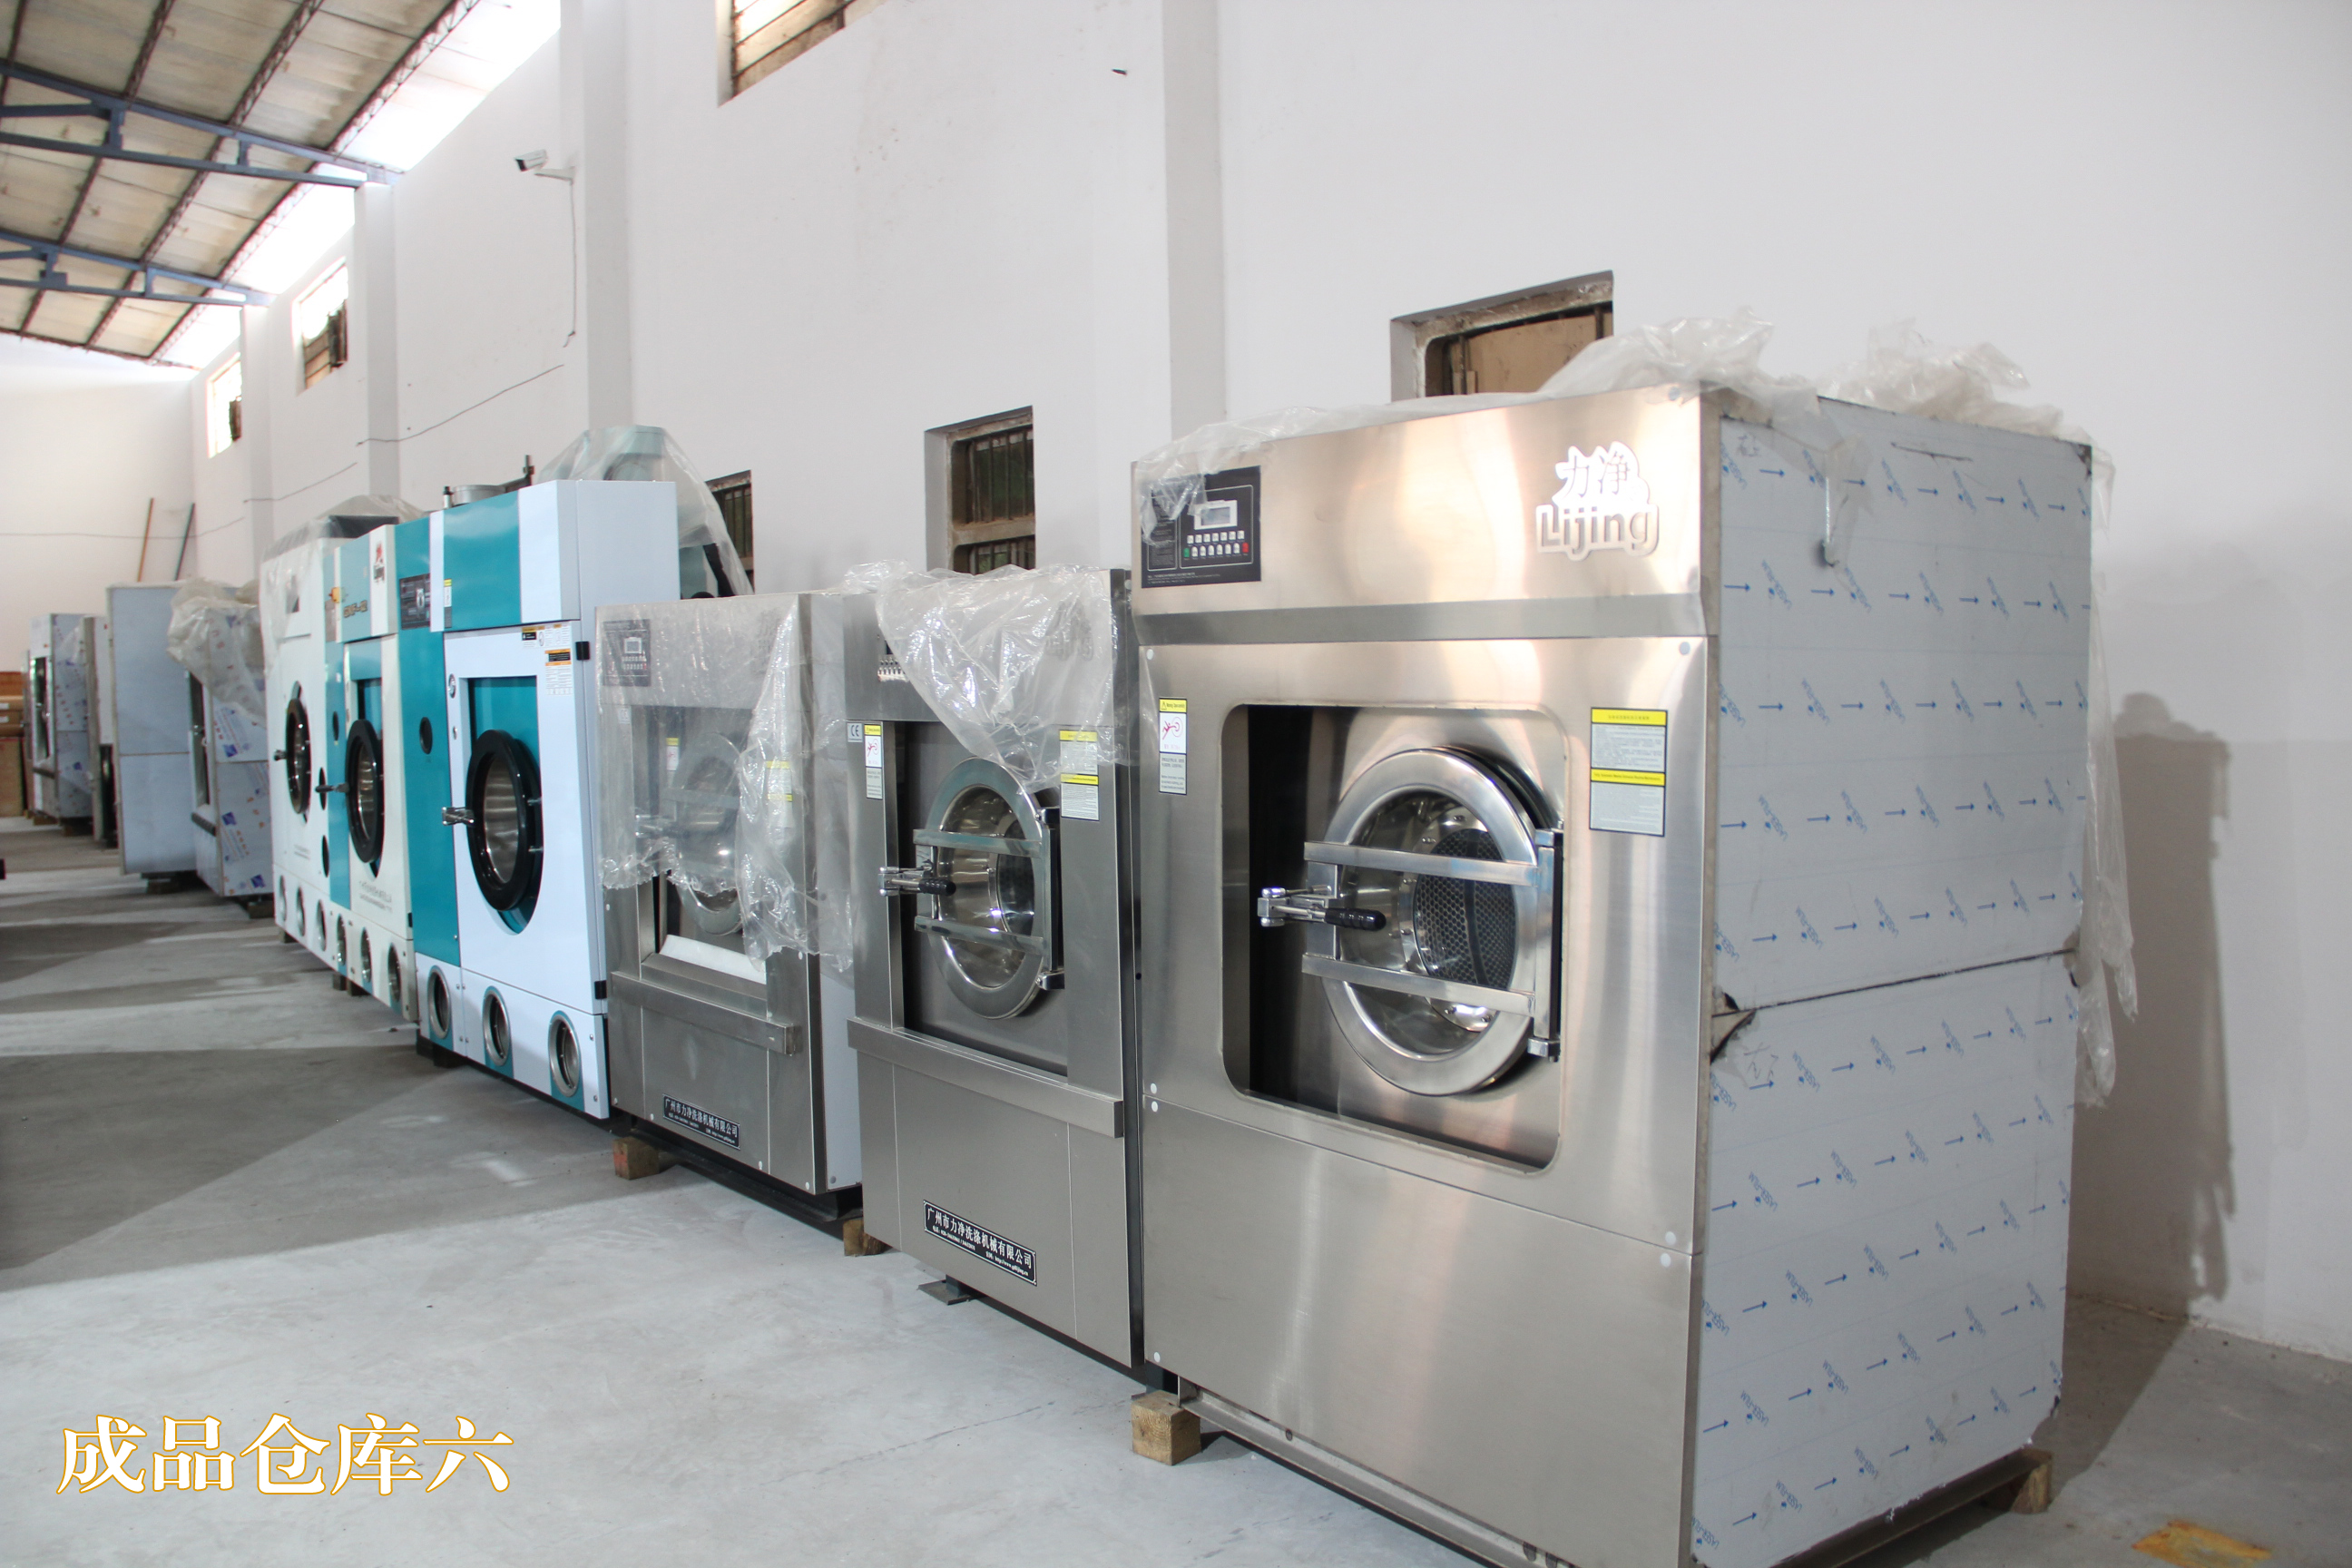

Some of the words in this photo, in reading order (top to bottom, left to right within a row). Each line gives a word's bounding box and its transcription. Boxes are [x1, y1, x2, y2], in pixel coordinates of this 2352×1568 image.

[1557, 446, 1635, 498] 力净
[1539, 505, 1651, 557] Lijing
[850, 724, 860, 738] CE
[927, 1207, 1032, 1269] 广州市力净洗涤机械有限公司
